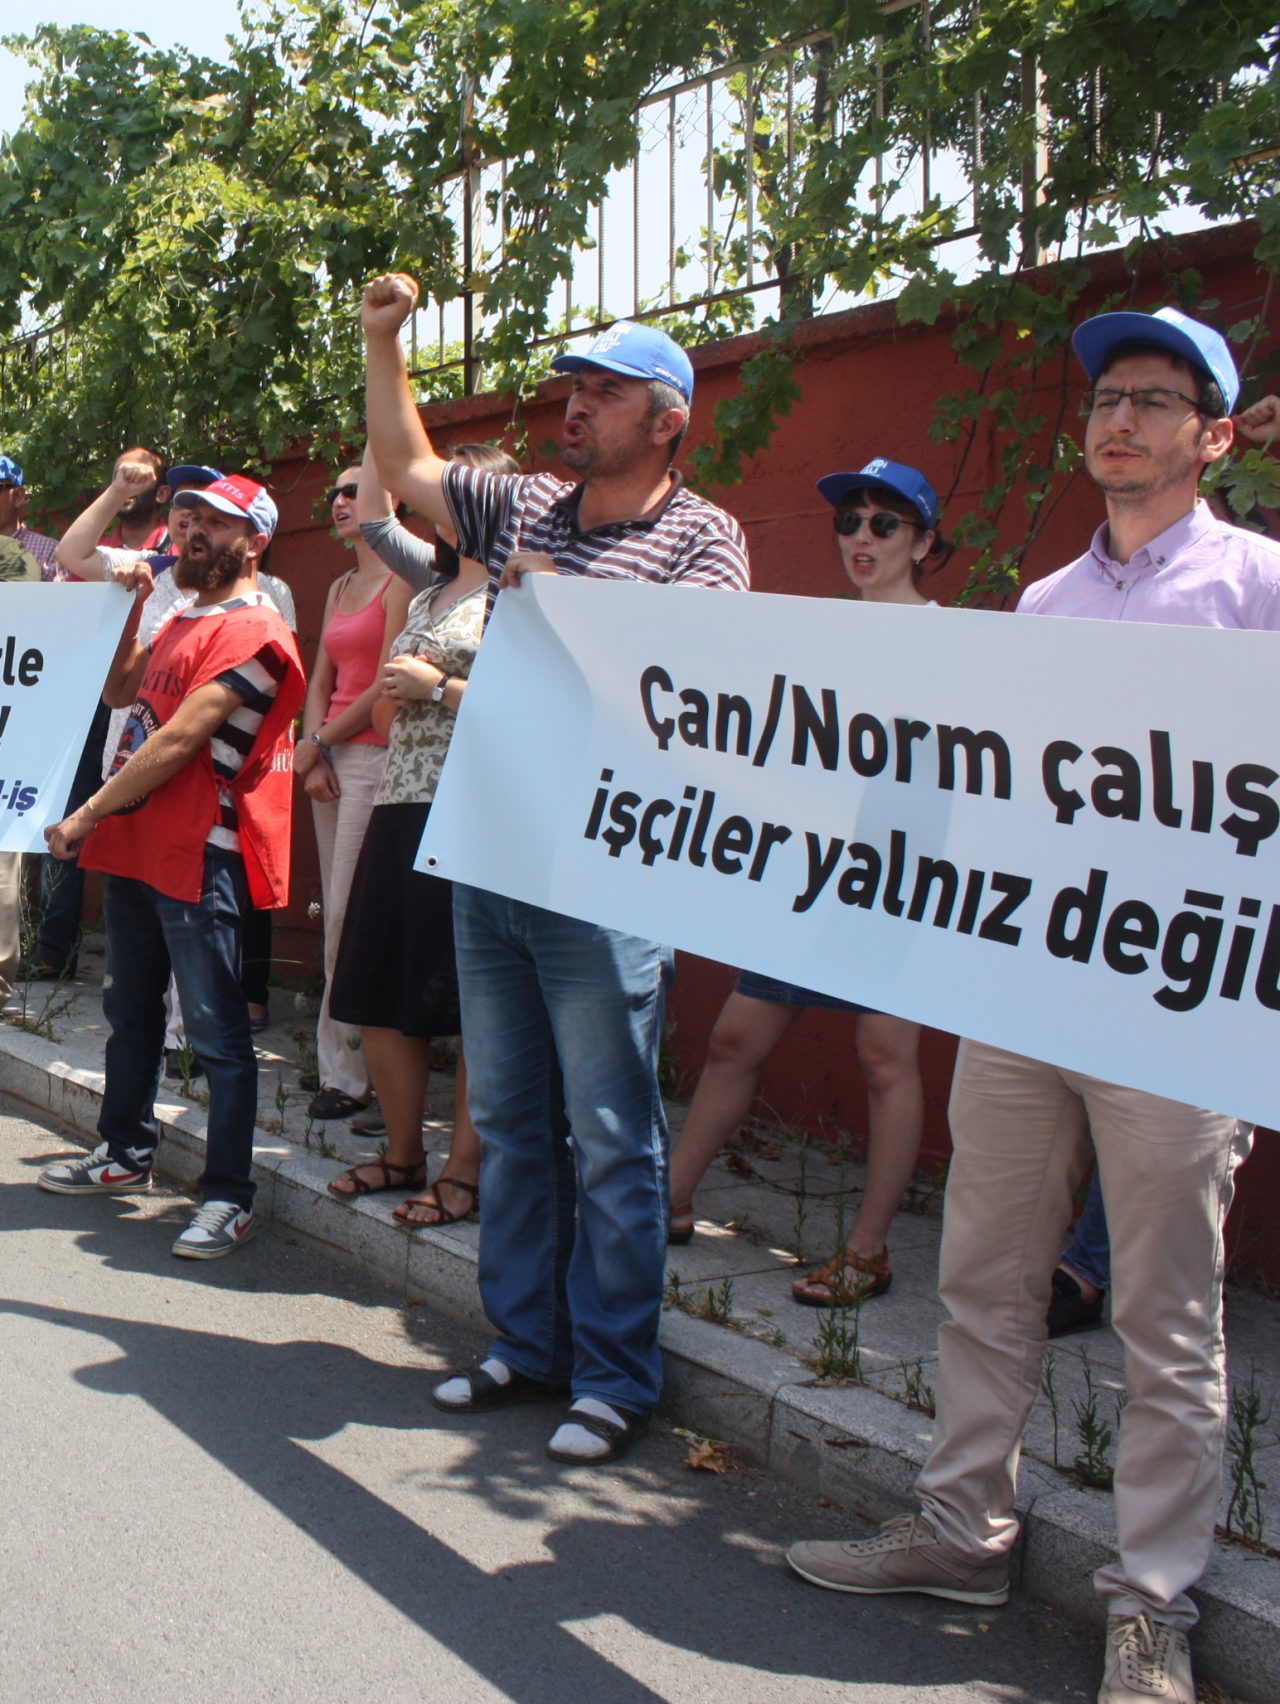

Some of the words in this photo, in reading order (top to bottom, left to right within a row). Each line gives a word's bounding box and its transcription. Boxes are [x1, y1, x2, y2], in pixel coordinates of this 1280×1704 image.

[639, 664, 1011, 801] Çan/Norm
[1041, 730, 1280, 857] çalış
[584, 768, 792, 882] işçiler
[791, 829, 1032, 947] yalnız
[1046, 868, 1280, 1013] değil
